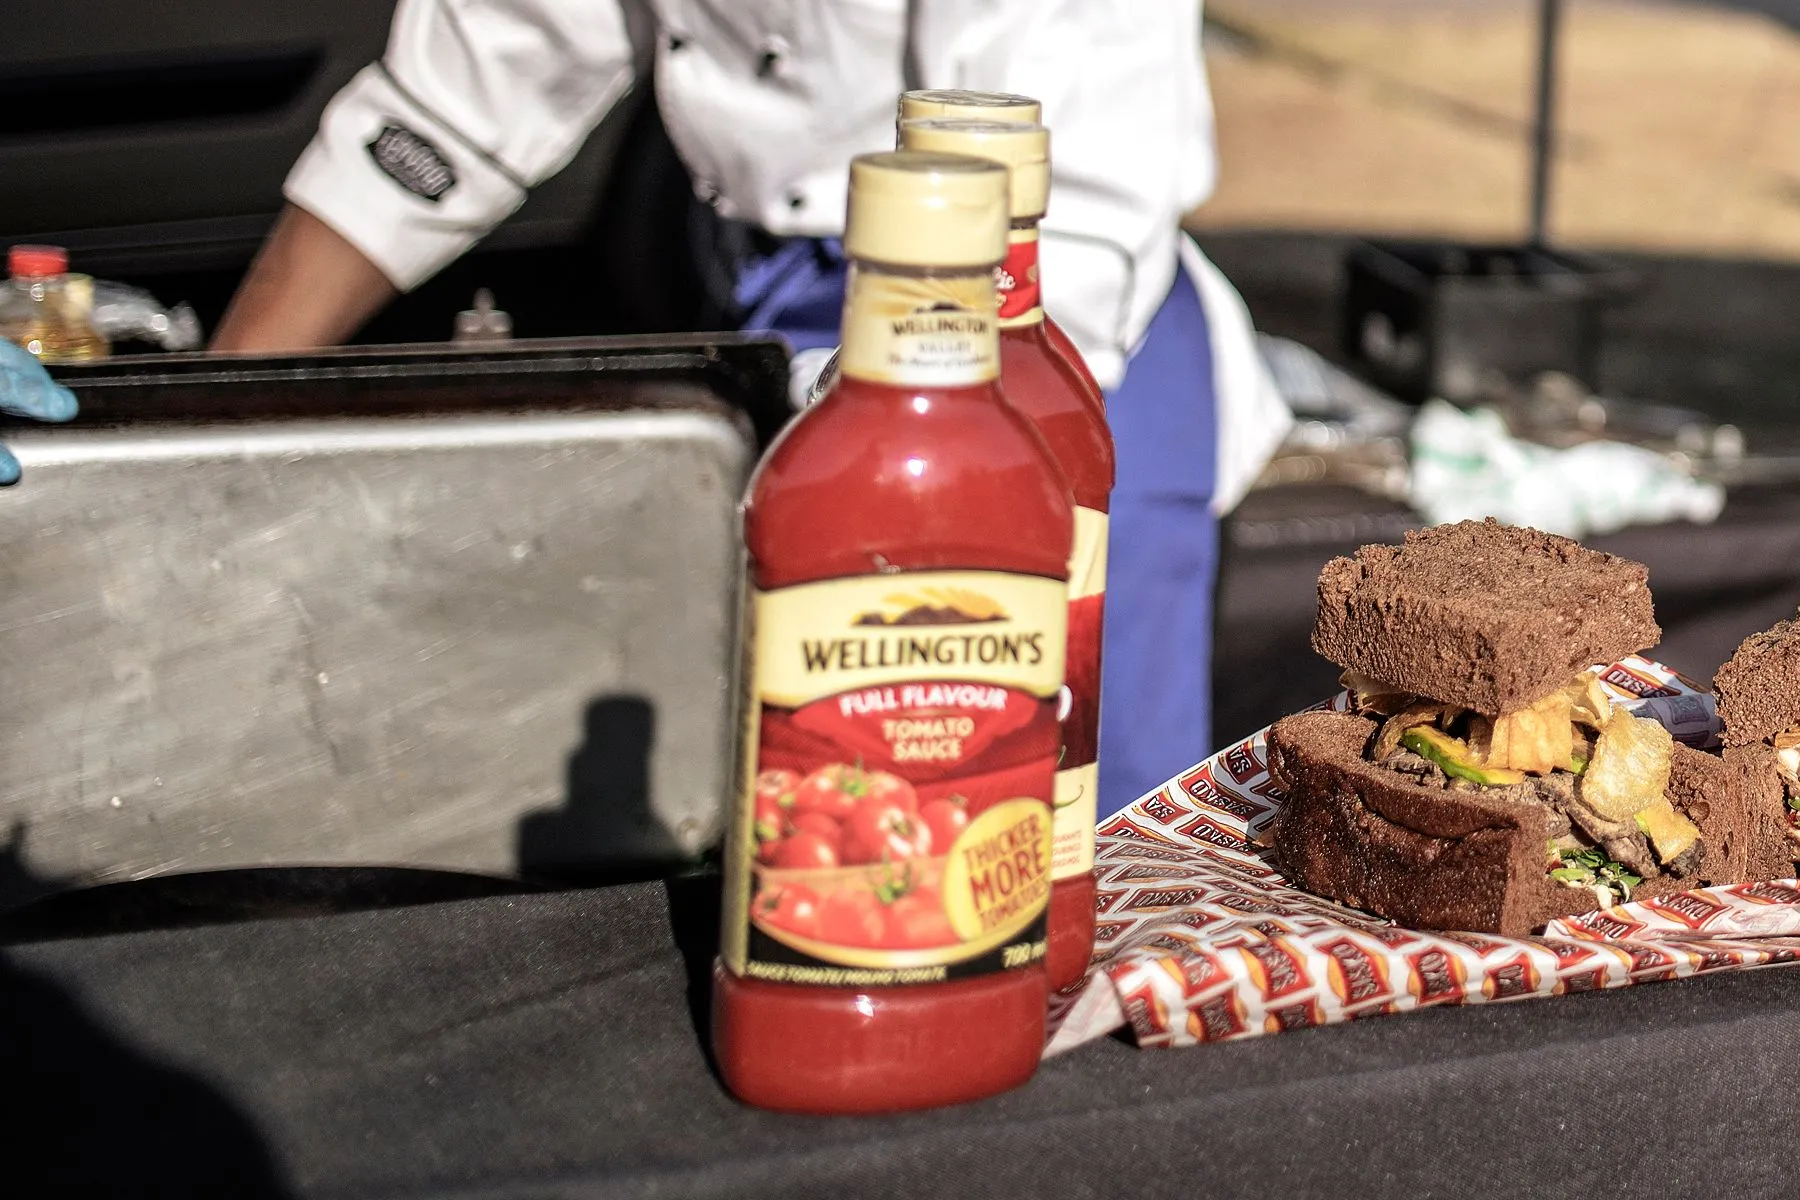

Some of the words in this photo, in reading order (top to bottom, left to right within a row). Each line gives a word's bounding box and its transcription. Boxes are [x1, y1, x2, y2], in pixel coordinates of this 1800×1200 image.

[802, 632, 1043, 672] WELLINGTON'S
[839, 688, 899, 717] FULL
[901, 684, 1008, 710] FLAVOUR
[882, 717, 975, 741] TOMATO
[893, 738, 962, 761] SAUCE
[969, 838, 1046, 912] MORE
